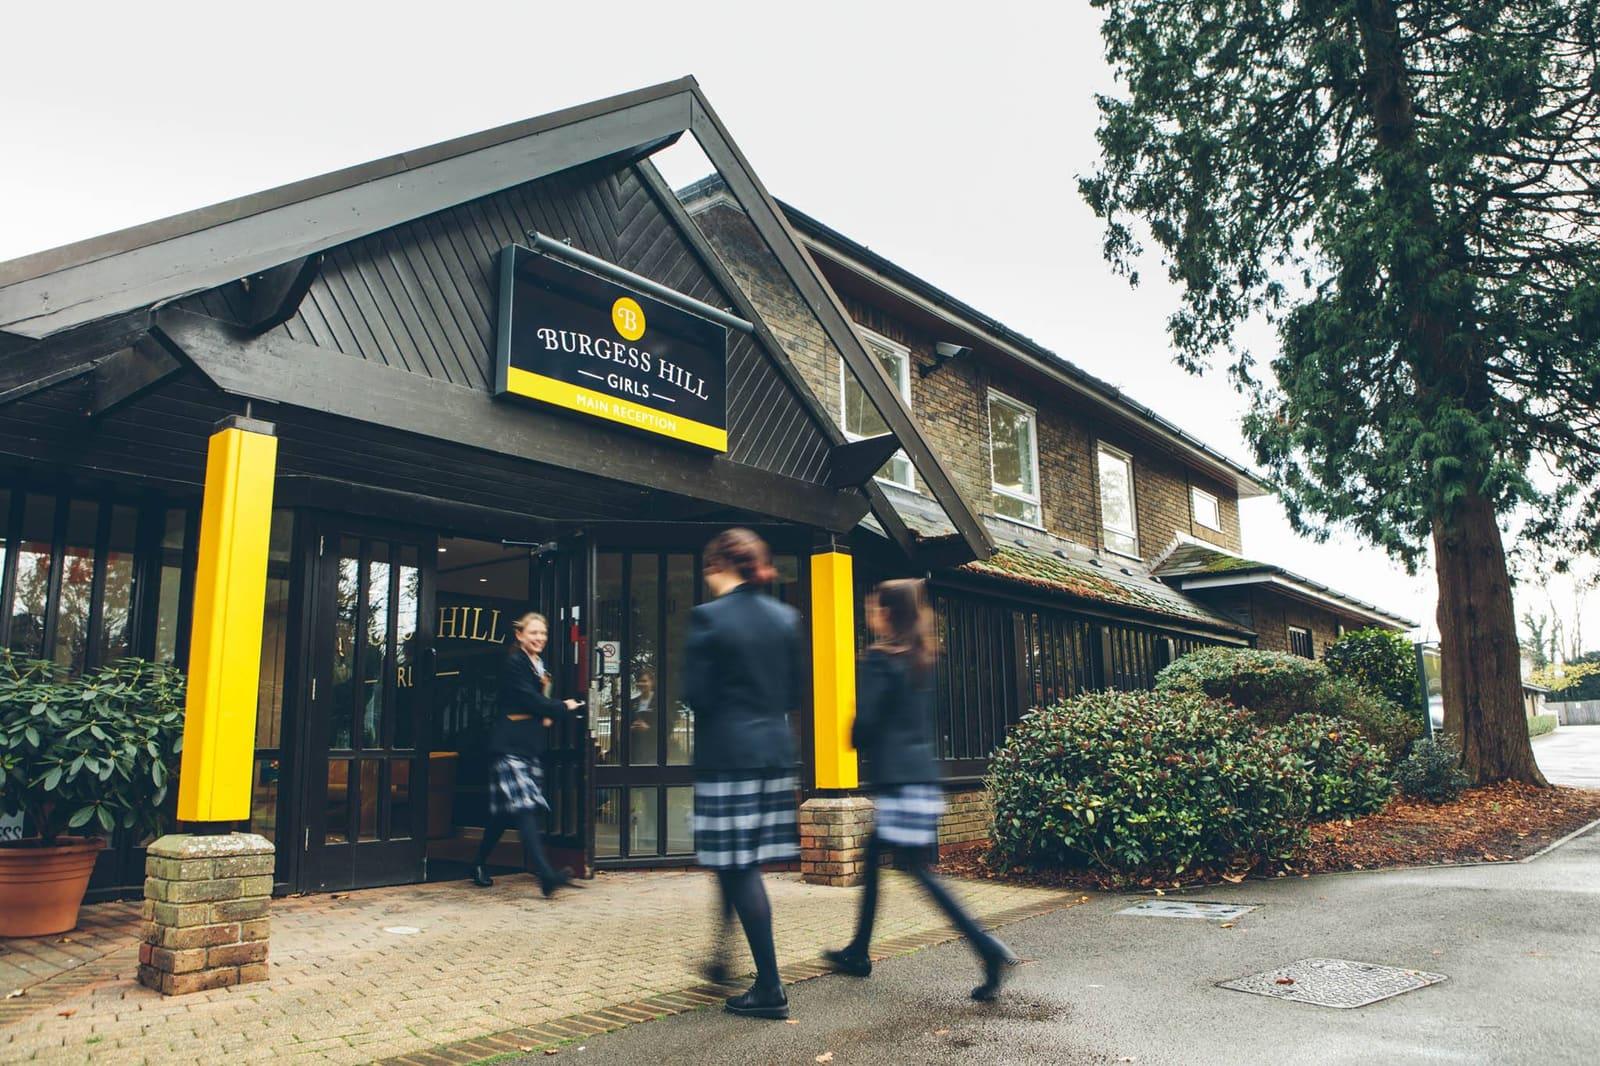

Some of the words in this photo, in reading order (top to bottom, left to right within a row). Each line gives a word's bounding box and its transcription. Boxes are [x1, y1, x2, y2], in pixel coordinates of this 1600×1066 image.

[617, 306, 637, 332] B
[537, 328, 651, 372] BURGESS
[658, 358, 709, 401] HILL
[607, 373, 649, 398] GIRLS
[576, 394, 609, 412] MAIN
[613, 403, 676, 432] RECEPTION
[437, 606, 506, 644] HILL
